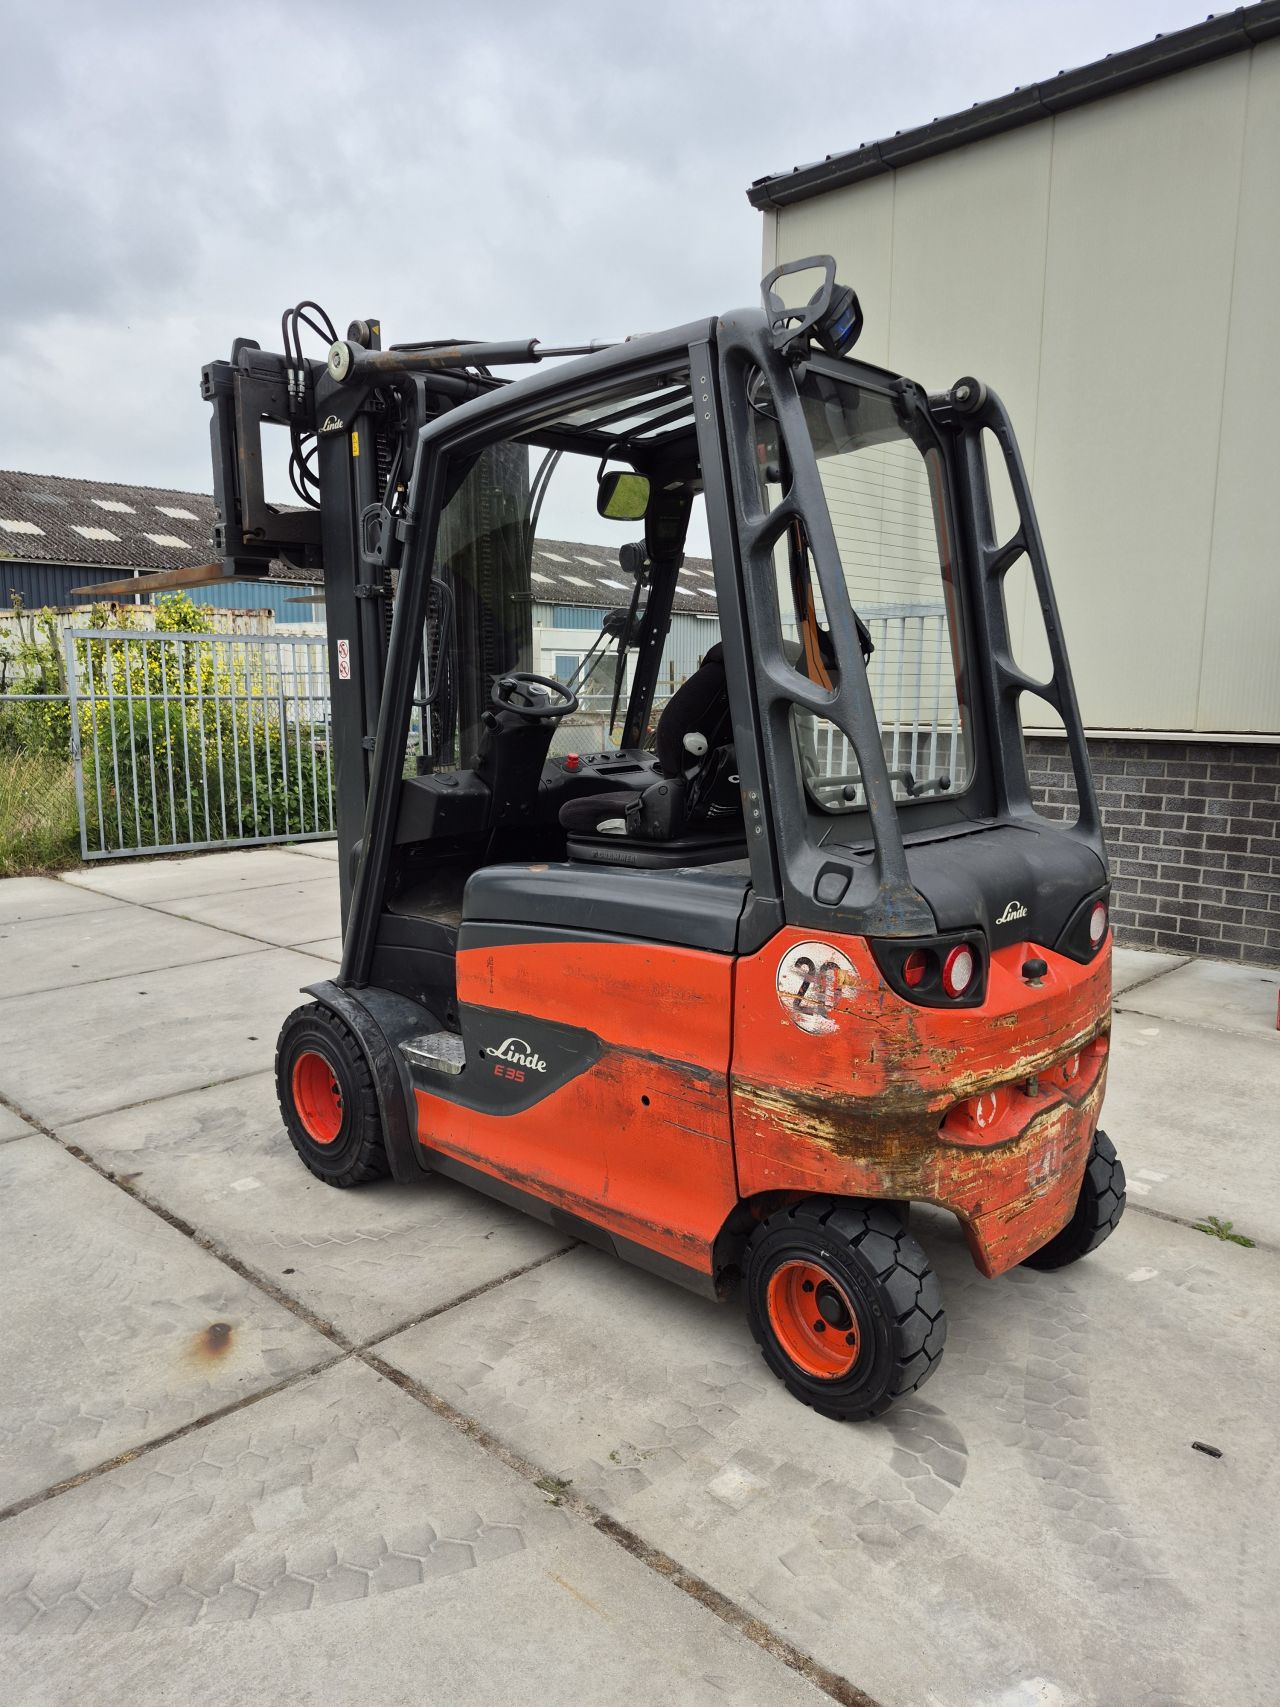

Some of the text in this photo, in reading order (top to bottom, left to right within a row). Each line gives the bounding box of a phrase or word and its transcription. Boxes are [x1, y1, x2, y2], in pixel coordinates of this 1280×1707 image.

[319, 415, 344, 432] Linde
[995, 900, 1028, 925] Linde
[485, 1038, 547, 1073] Linde
